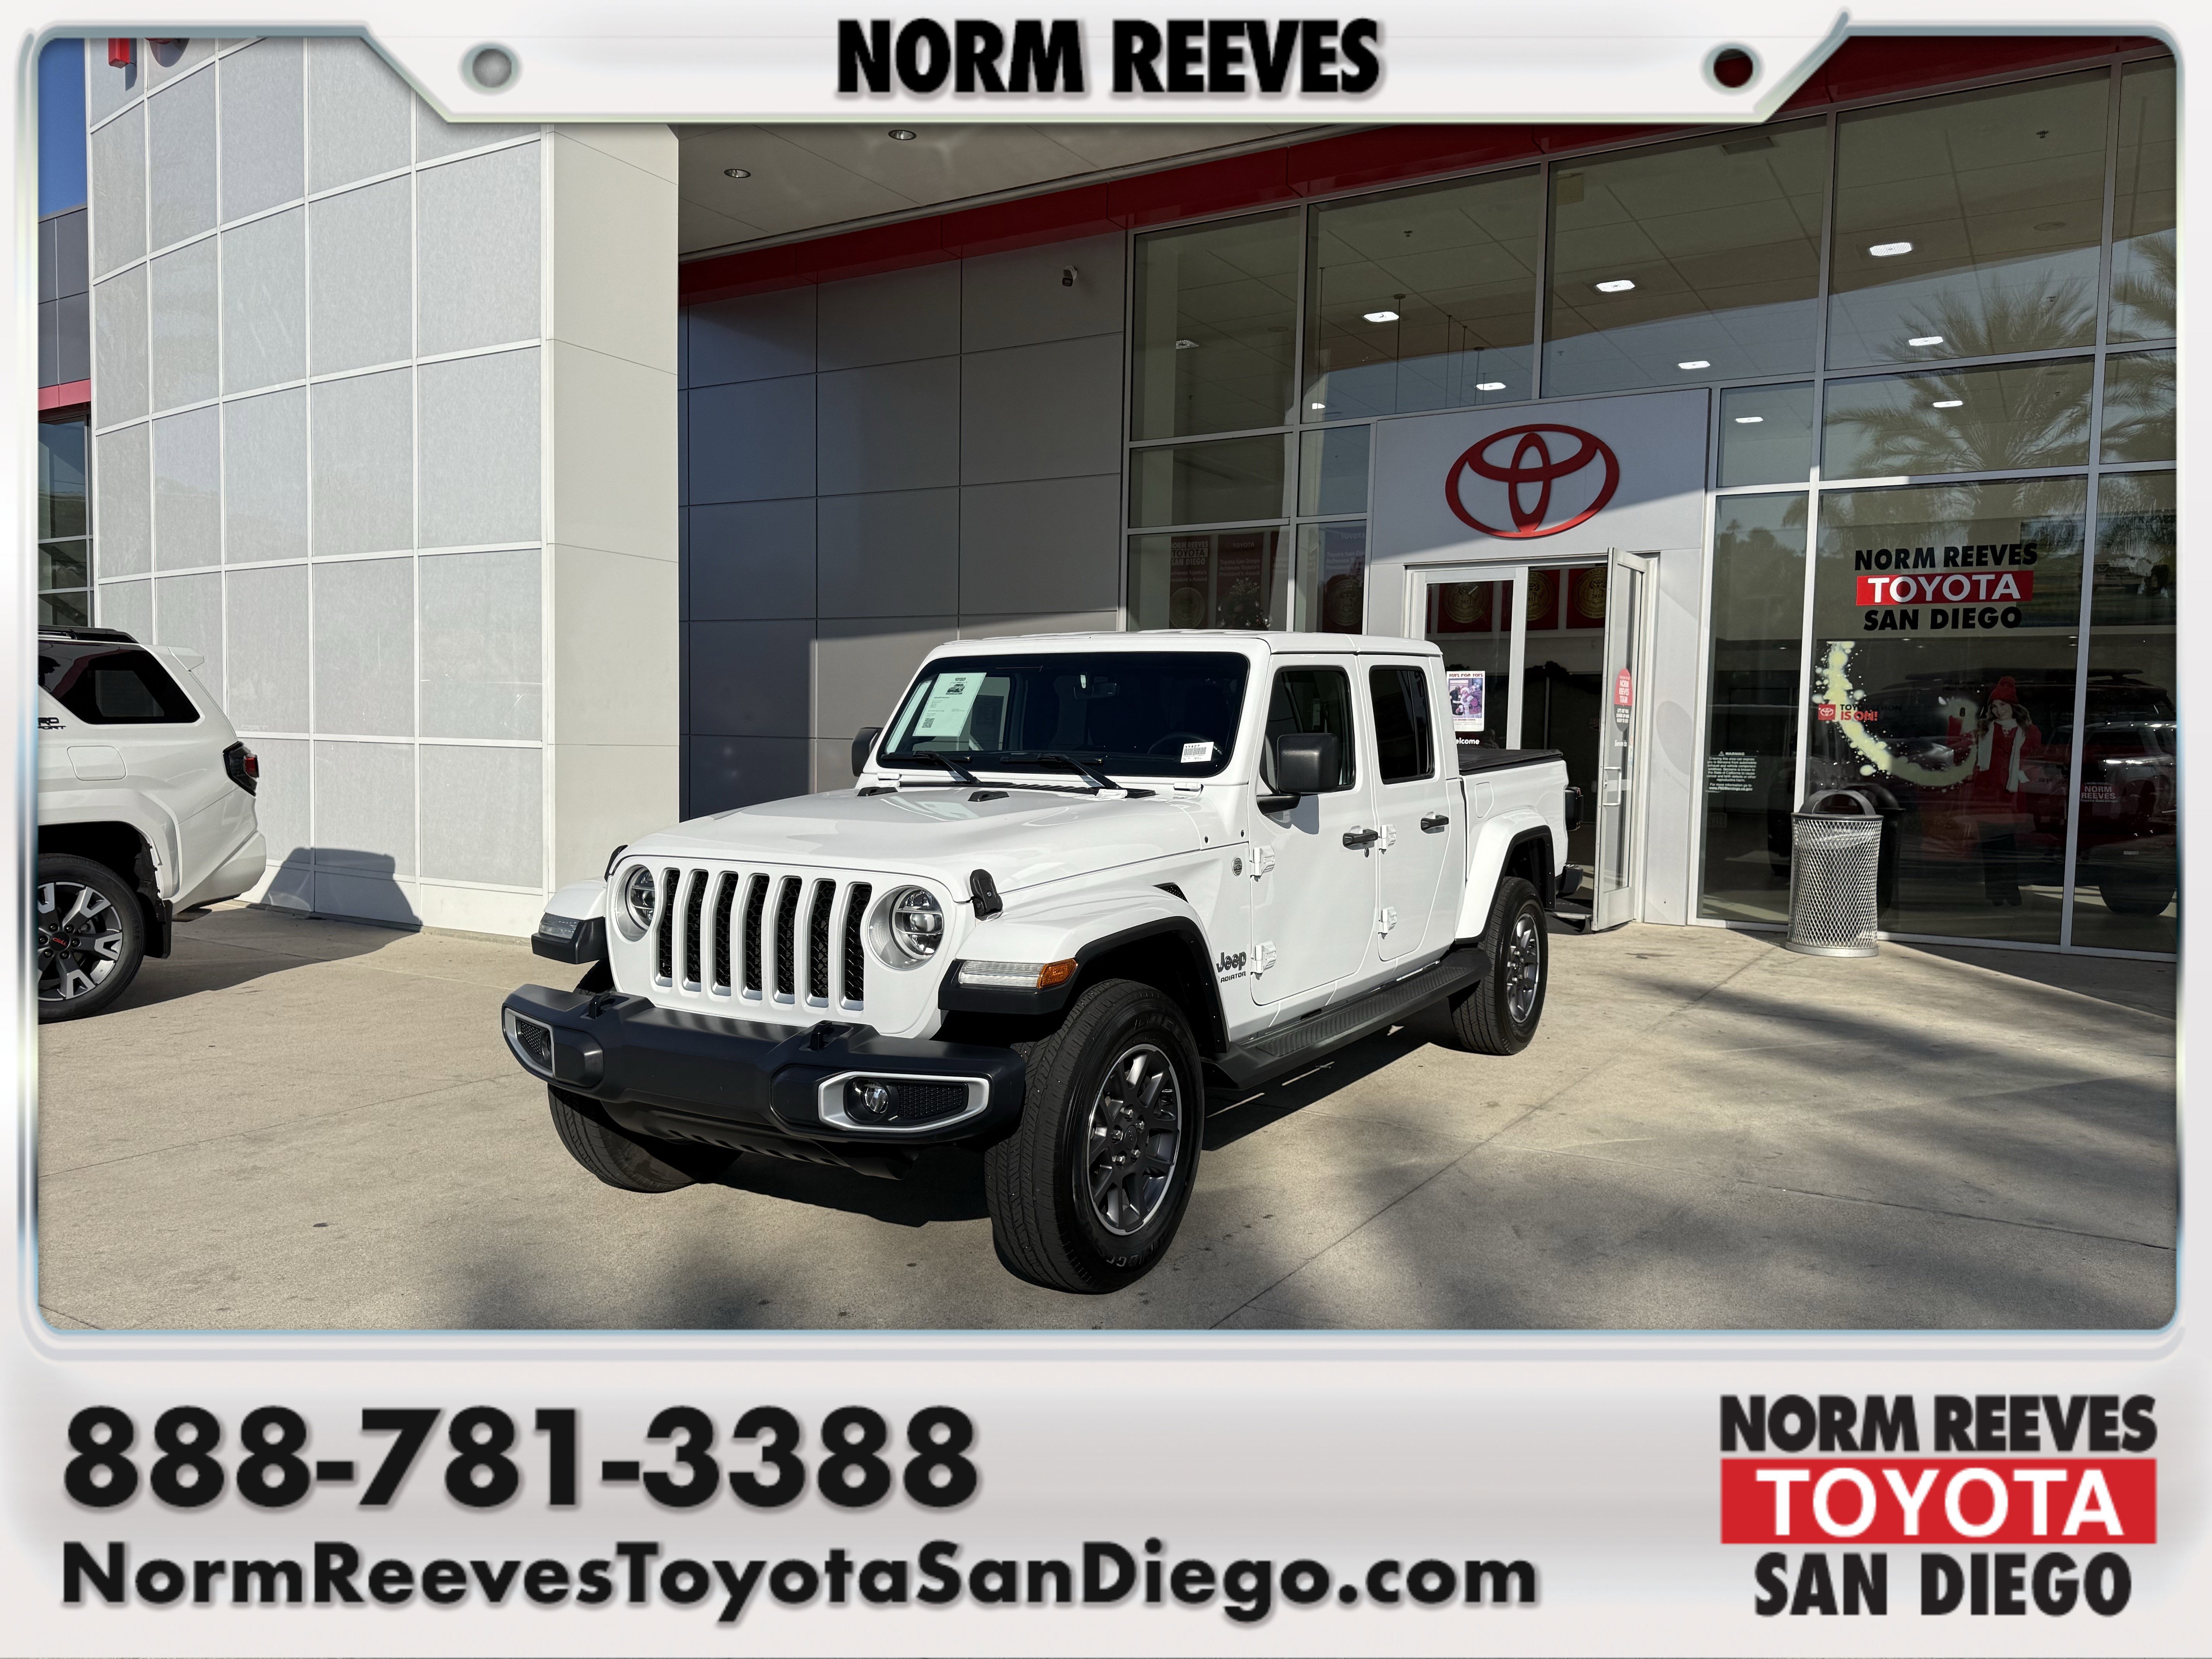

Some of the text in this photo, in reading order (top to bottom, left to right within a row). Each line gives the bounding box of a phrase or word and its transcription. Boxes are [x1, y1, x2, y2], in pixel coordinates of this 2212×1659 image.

[1171, 549, 1205, 557] TOYOTA
[1855, 543, 2038, 571] NORM REEVES
[1185, 557, 1206, 565] DIEGO
[1867, 574, 2021, 603] TOYOTA
[1863, 606, 2022, 631] SAN DIEGO
[38, 717, 60, 726] RD
[1841, 711, 1878, 721] IS ON!
[1216, 951, 1247, 973] Jeep
[1220, 971, 1246, 983] ADIATOR
